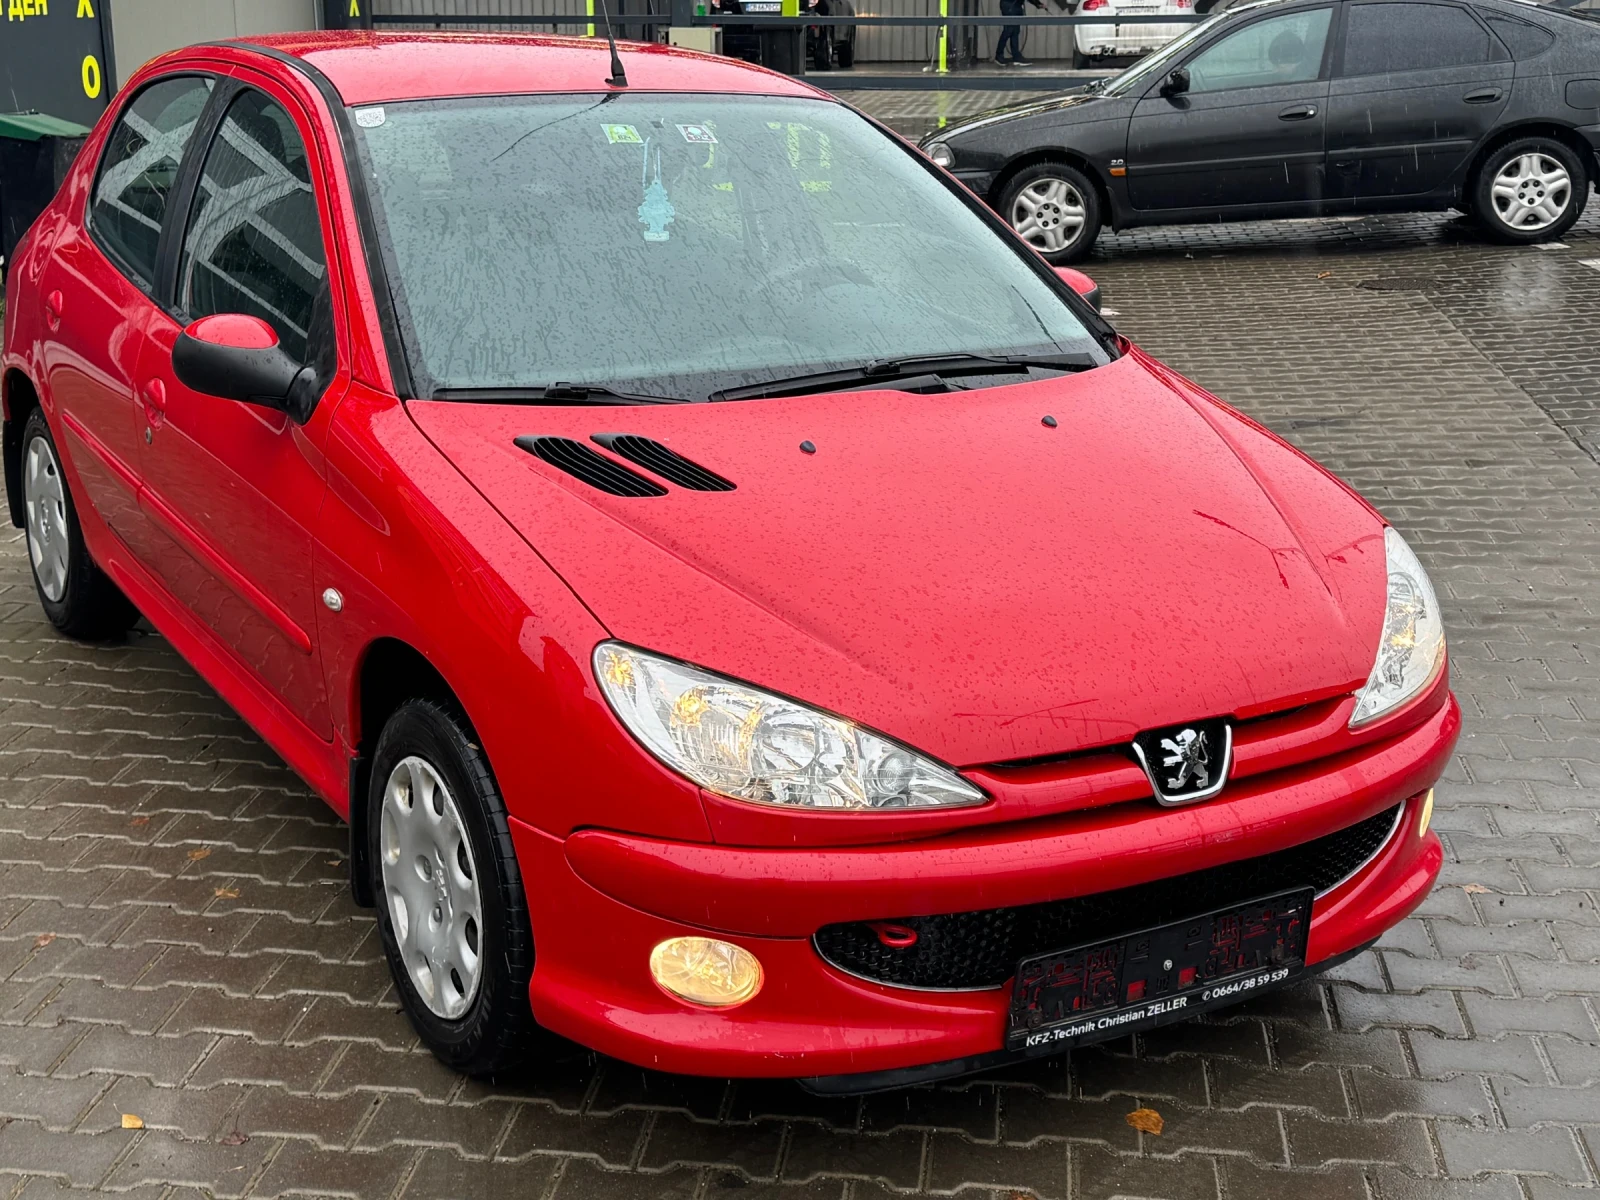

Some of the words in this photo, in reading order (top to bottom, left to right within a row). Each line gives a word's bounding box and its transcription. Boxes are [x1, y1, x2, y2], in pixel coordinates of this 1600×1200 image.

[1026, 1021, 1096, 1047] KFZ-Technik
[1097, 1008, 1145, 1029] Christian
[1147, 996, 1188, 1017] ZELLER
[1212, 977, 1256, 998] 0664/38
[1257, 973, 1270, 986] 59
[1271, 968, 1289, 982] 539
